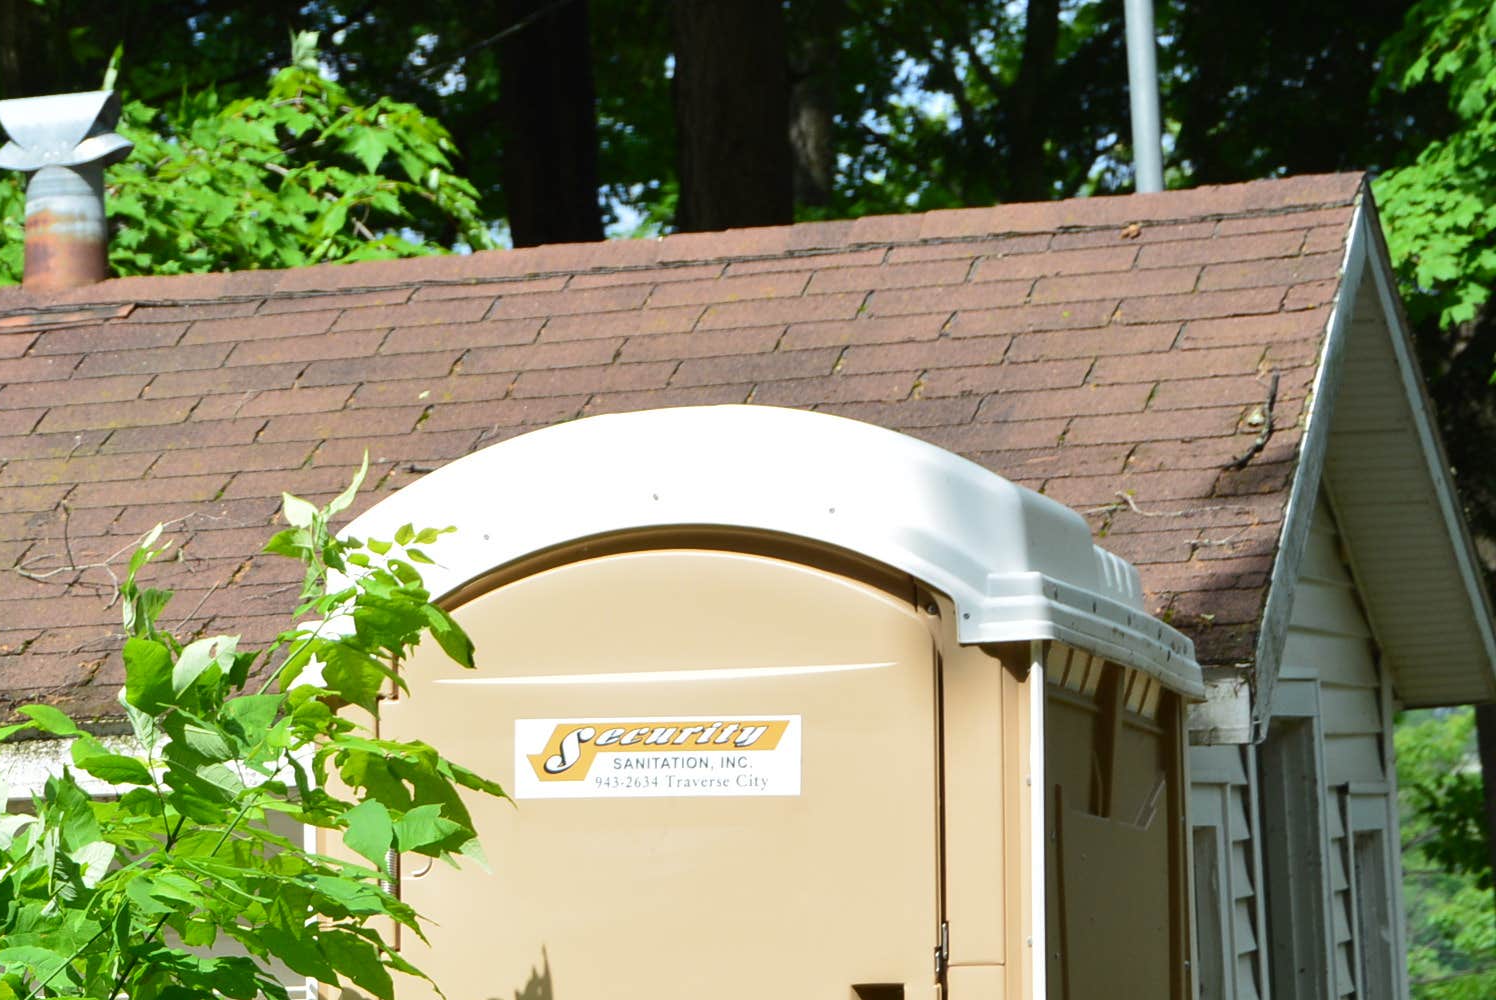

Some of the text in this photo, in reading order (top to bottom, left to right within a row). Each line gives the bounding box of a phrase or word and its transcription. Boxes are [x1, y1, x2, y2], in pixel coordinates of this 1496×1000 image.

[543, 721, 768, 774] Security
[613, 756, 753, 771] SANITATION, INC.
[595, 774, 769, 790] 943-2634 Traverse City
